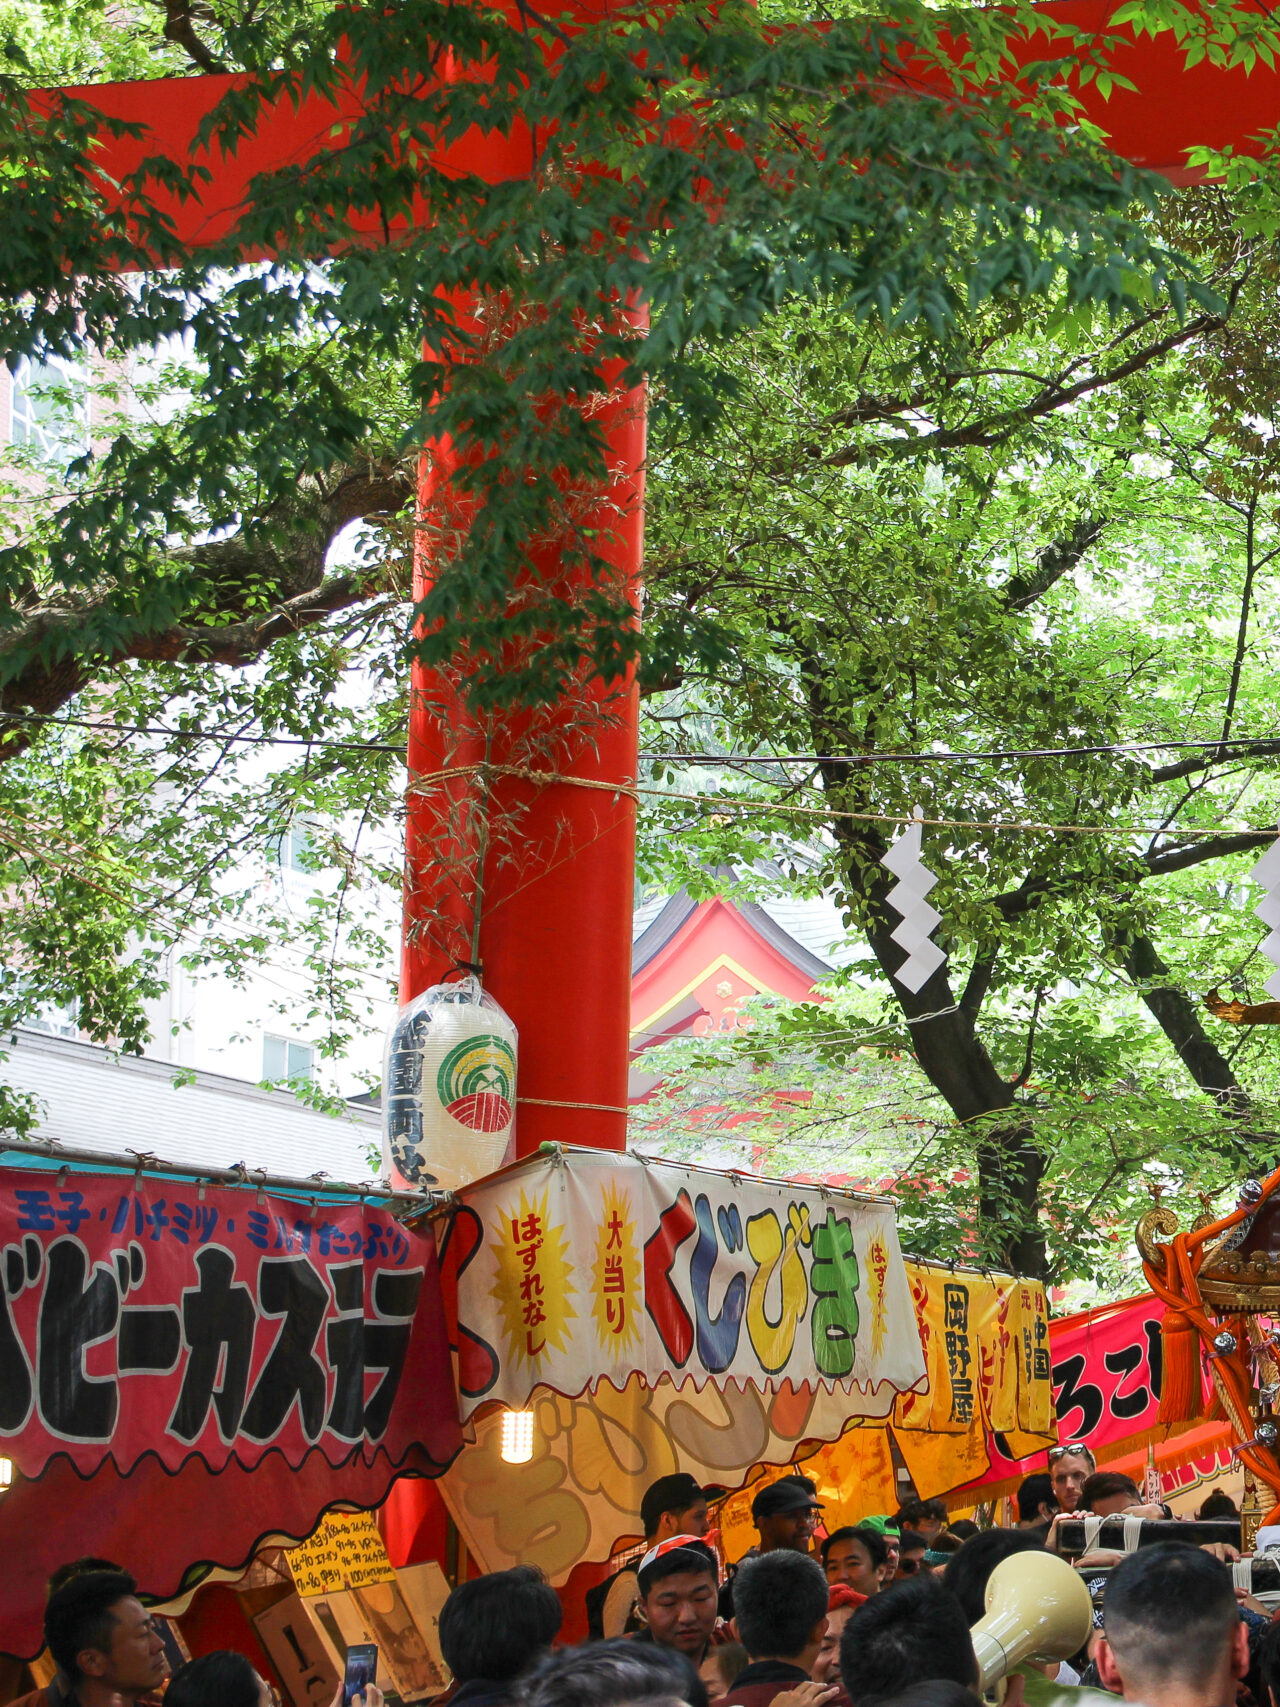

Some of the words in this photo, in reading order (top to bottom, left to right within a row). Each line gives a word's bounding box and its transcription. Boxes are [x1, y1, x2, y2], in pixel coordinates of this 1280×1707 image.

[511, 1213, 547, 1357] はずれなし
[603, 1210, 625, 1334] 大当り
[643, 1186, 860, 1379] くじびき
